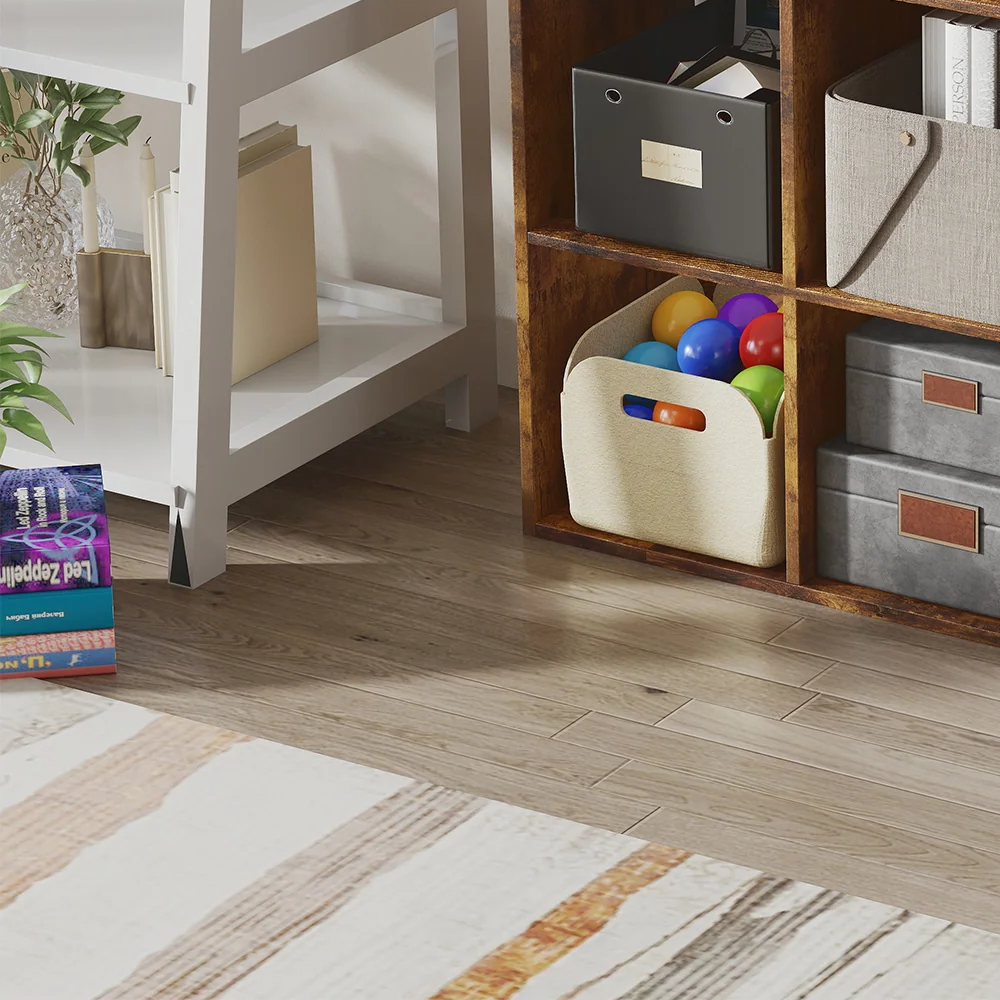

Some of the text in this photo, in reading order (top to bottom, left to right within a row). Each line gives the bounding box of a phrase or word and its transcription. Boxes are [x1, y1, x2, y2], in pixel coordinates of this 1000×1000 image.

[34, 486, 45, 497] Roll
[14, 488, 32, 530] Led Zeppelin
[35, 498, 46, 508] and
[36, 508, 47, 522] Rock
[64, 560, 92, 583] Led
[6, 611, 64, 622] Валерий Бабич
